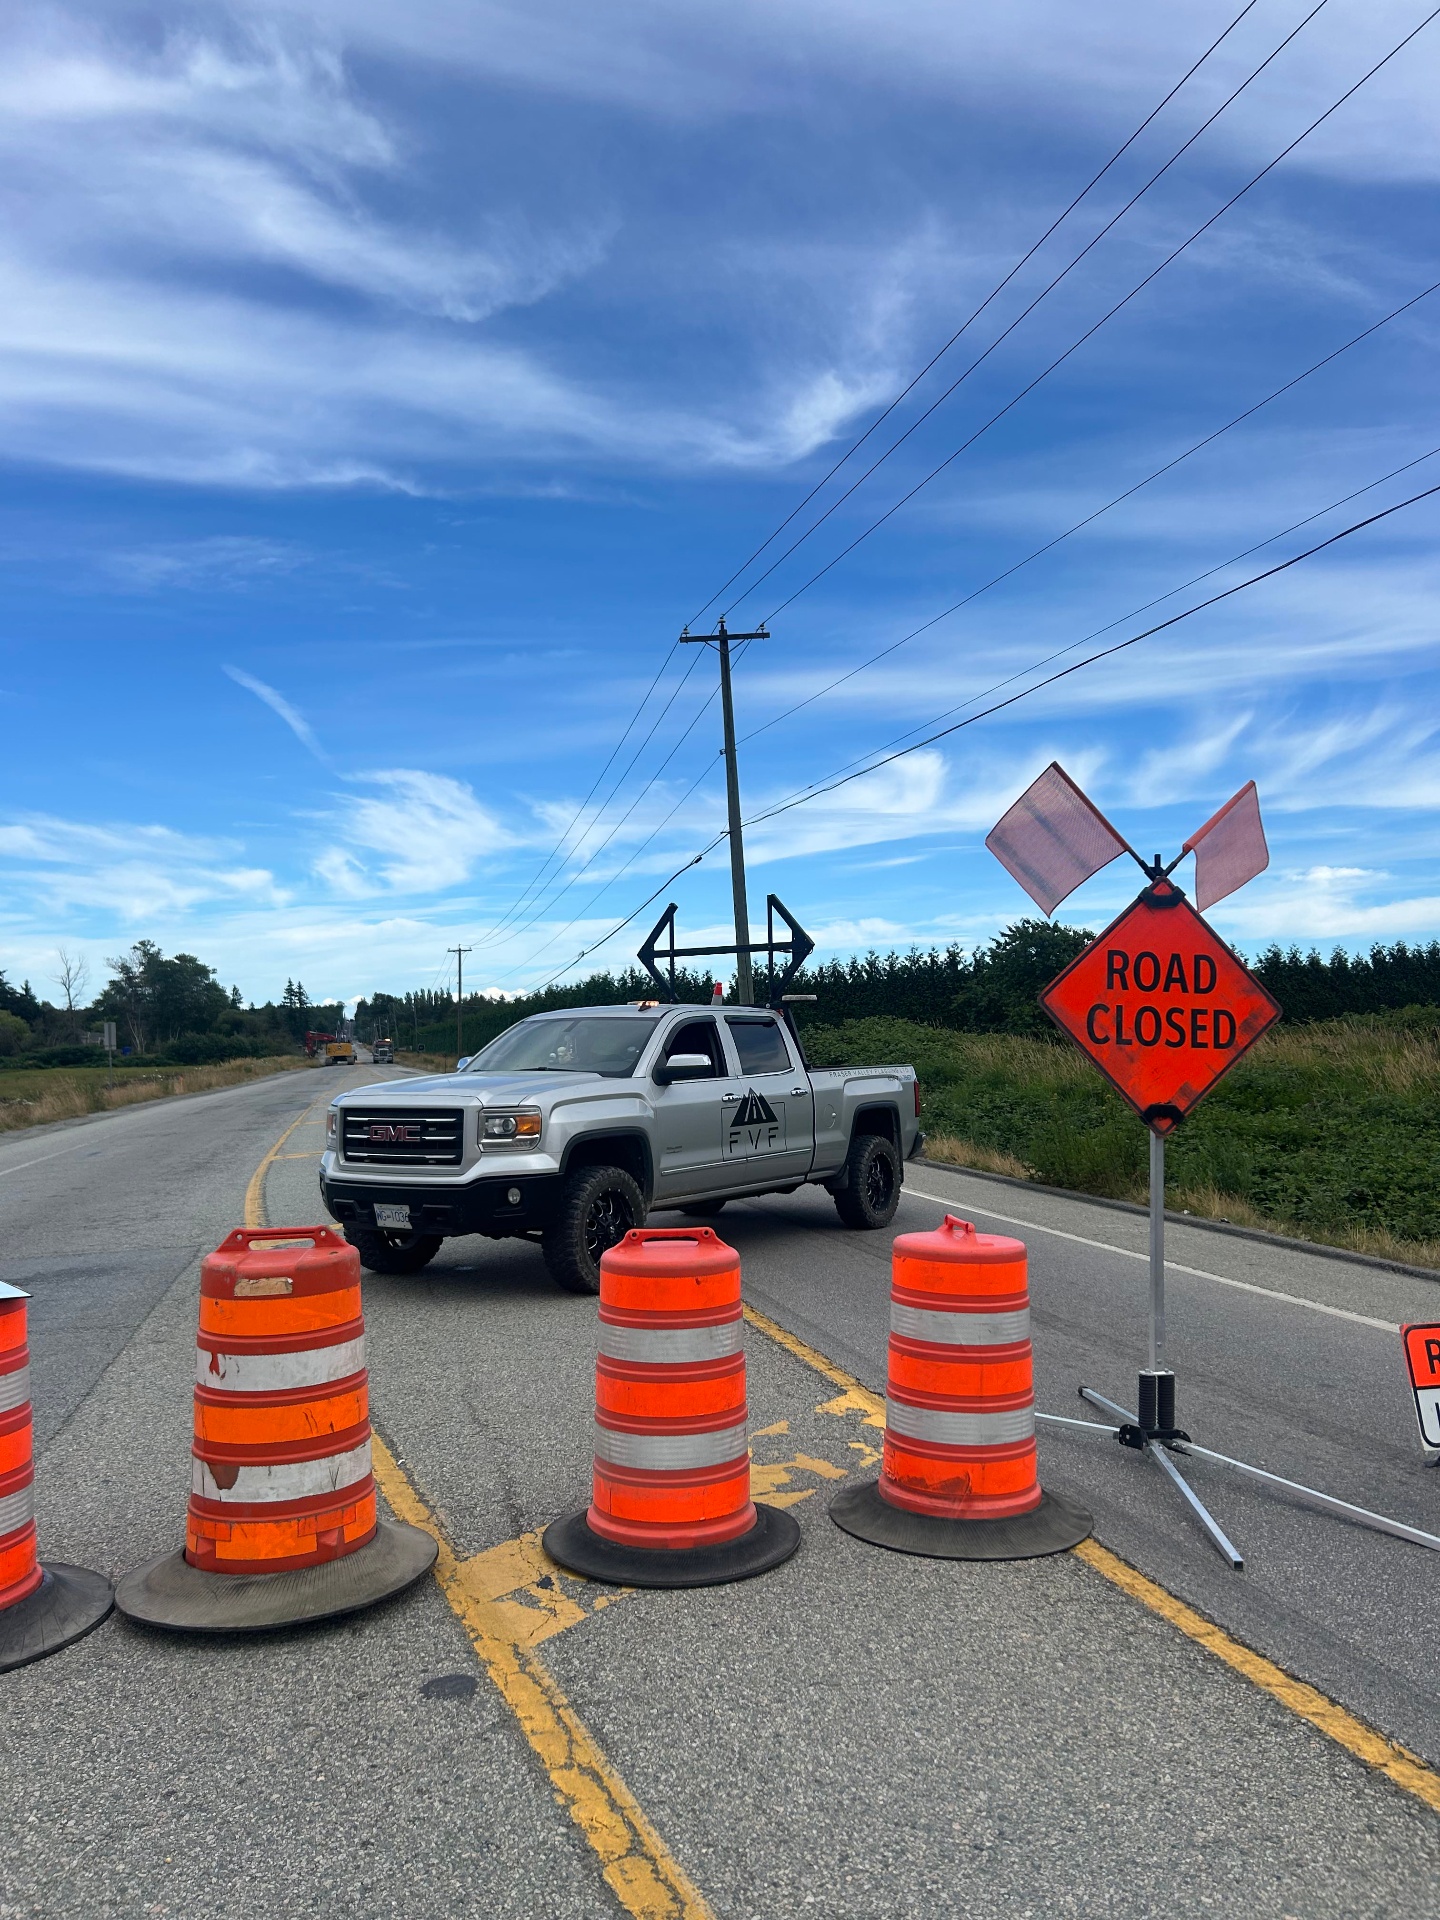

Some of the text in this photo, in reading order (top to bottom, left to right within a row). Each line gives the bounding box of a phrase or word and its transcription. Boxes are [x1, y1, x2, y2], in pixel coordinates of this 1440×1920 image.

[1106, 949, 1217, 994] ROAD
[1086, 1003, 1237, 1050] CLOSED
[369, 1125, 421, 1142] GMC
[729, 1127, 779, 1153] FVF
